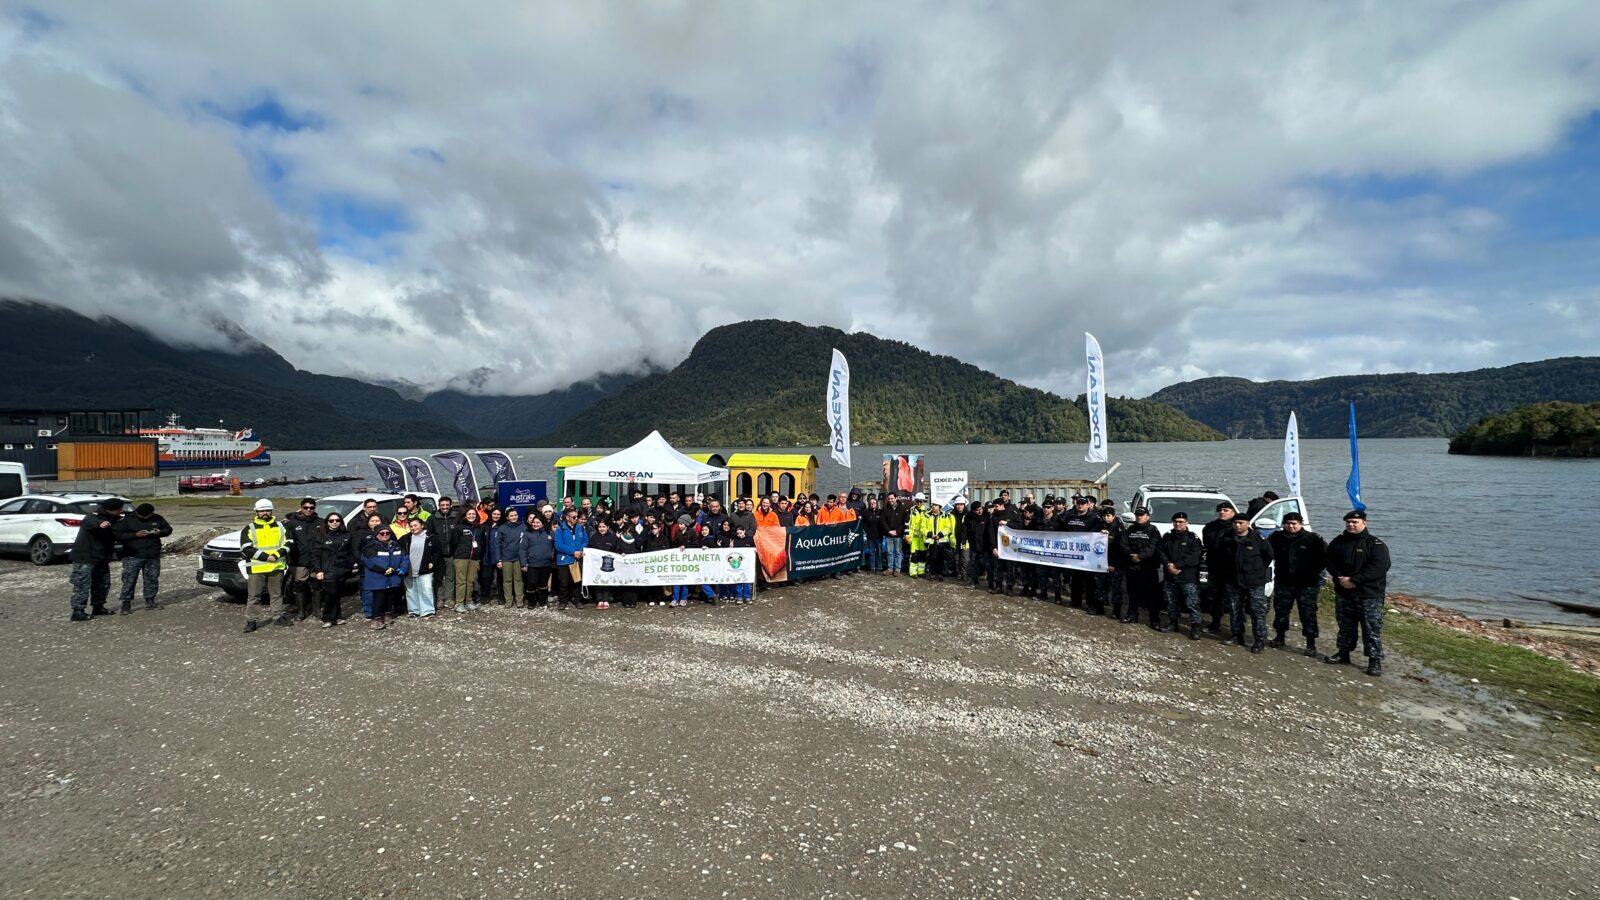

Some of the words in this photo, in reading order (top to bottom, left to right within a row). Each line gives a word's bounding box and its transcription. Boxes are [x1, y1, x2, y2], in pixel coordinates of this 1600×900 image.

[623, 555, 669, 565] CUIDEMOS
[670, 554, 680, 562] EL
[682, 553, 721, 562] PLANETA
[644, 565, 655, 574] ES
[657, 565, 669, 573] DE
[670, 564, 700, 573] TODOS
